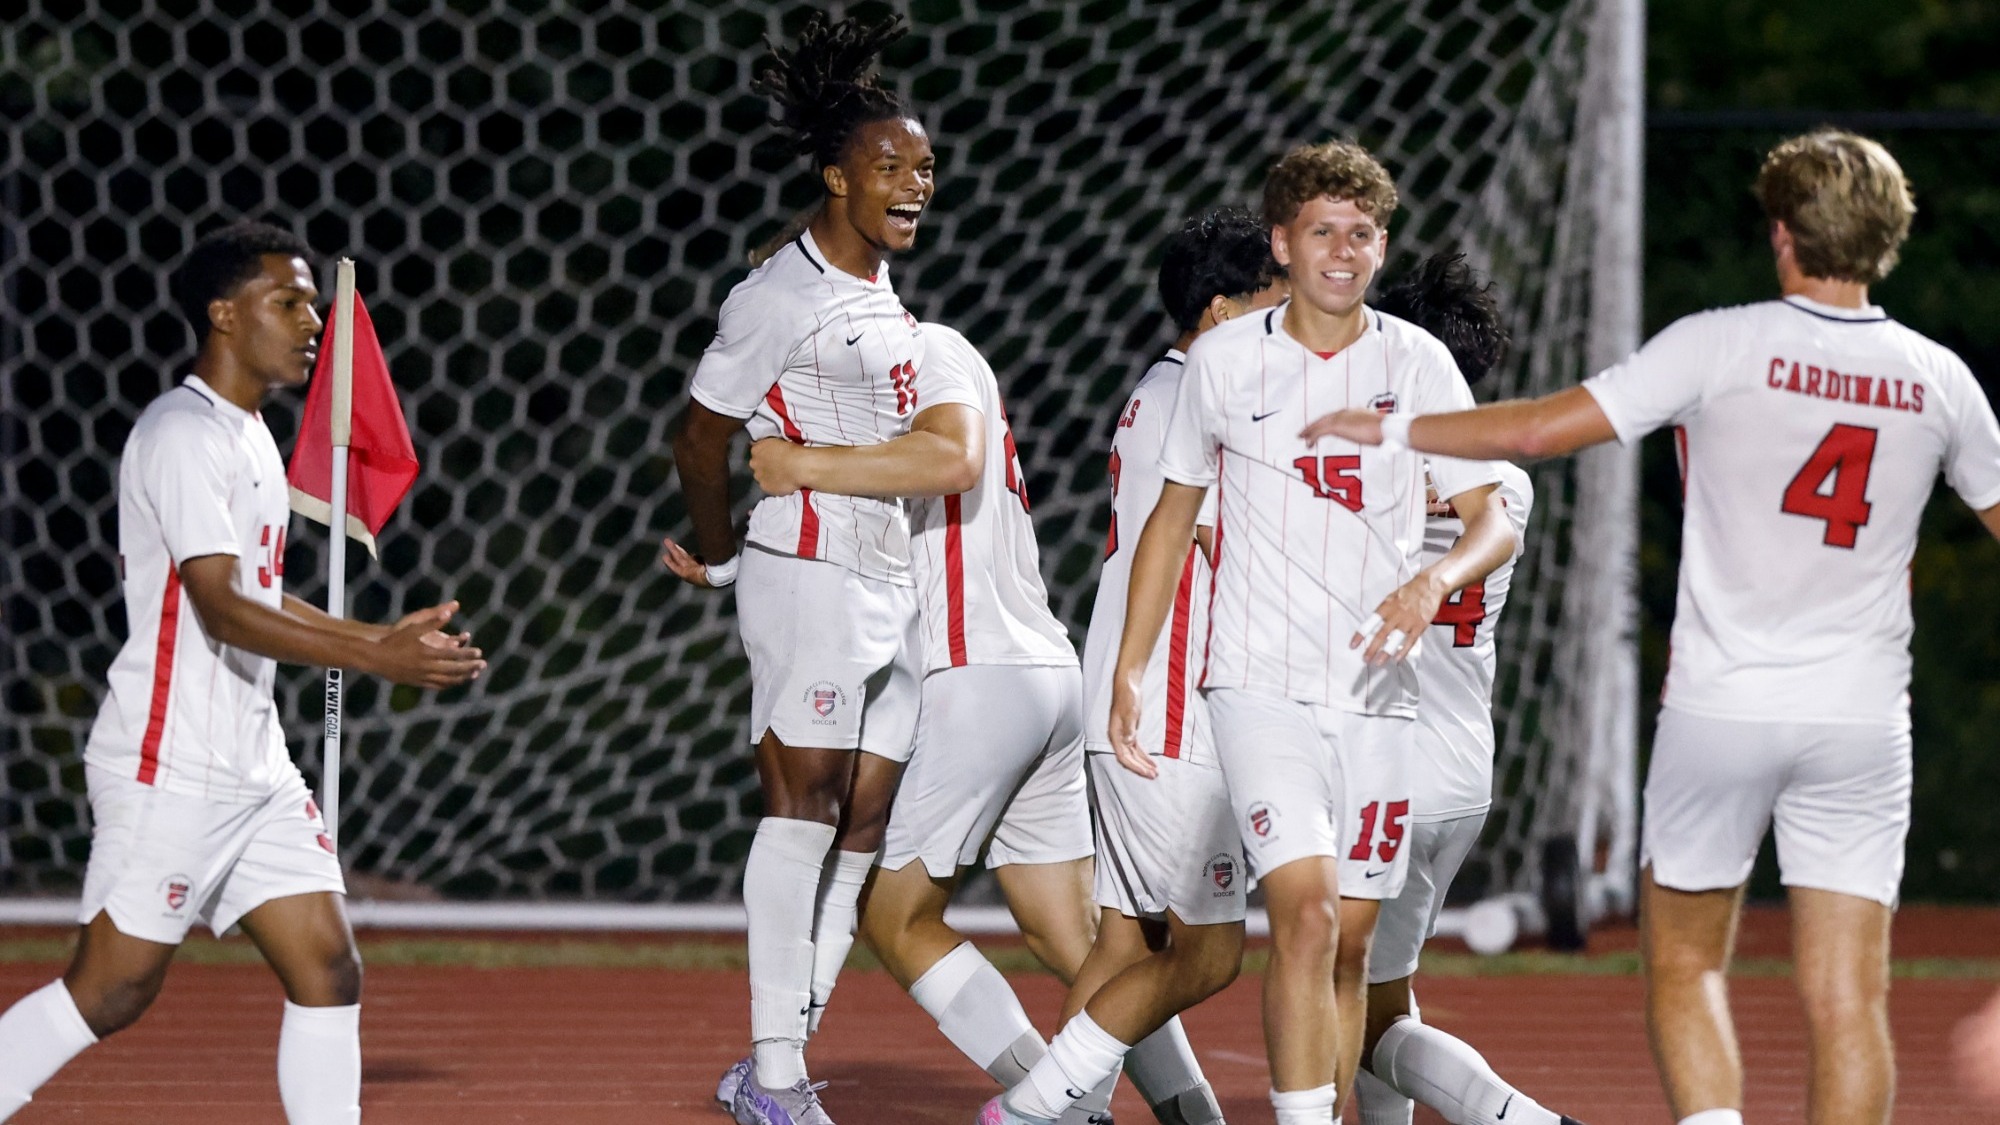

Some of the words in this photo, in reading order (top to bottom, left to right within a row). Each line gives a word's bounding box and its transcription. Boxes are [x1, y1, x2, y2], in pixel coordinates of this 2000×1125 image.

[1767, 357, 1925, 414] CARDINALS
[1293, 455, 1364, 512] 15
[1781, 422, 1878, 549] 4
[1348, 799, 1409, 862] 15
